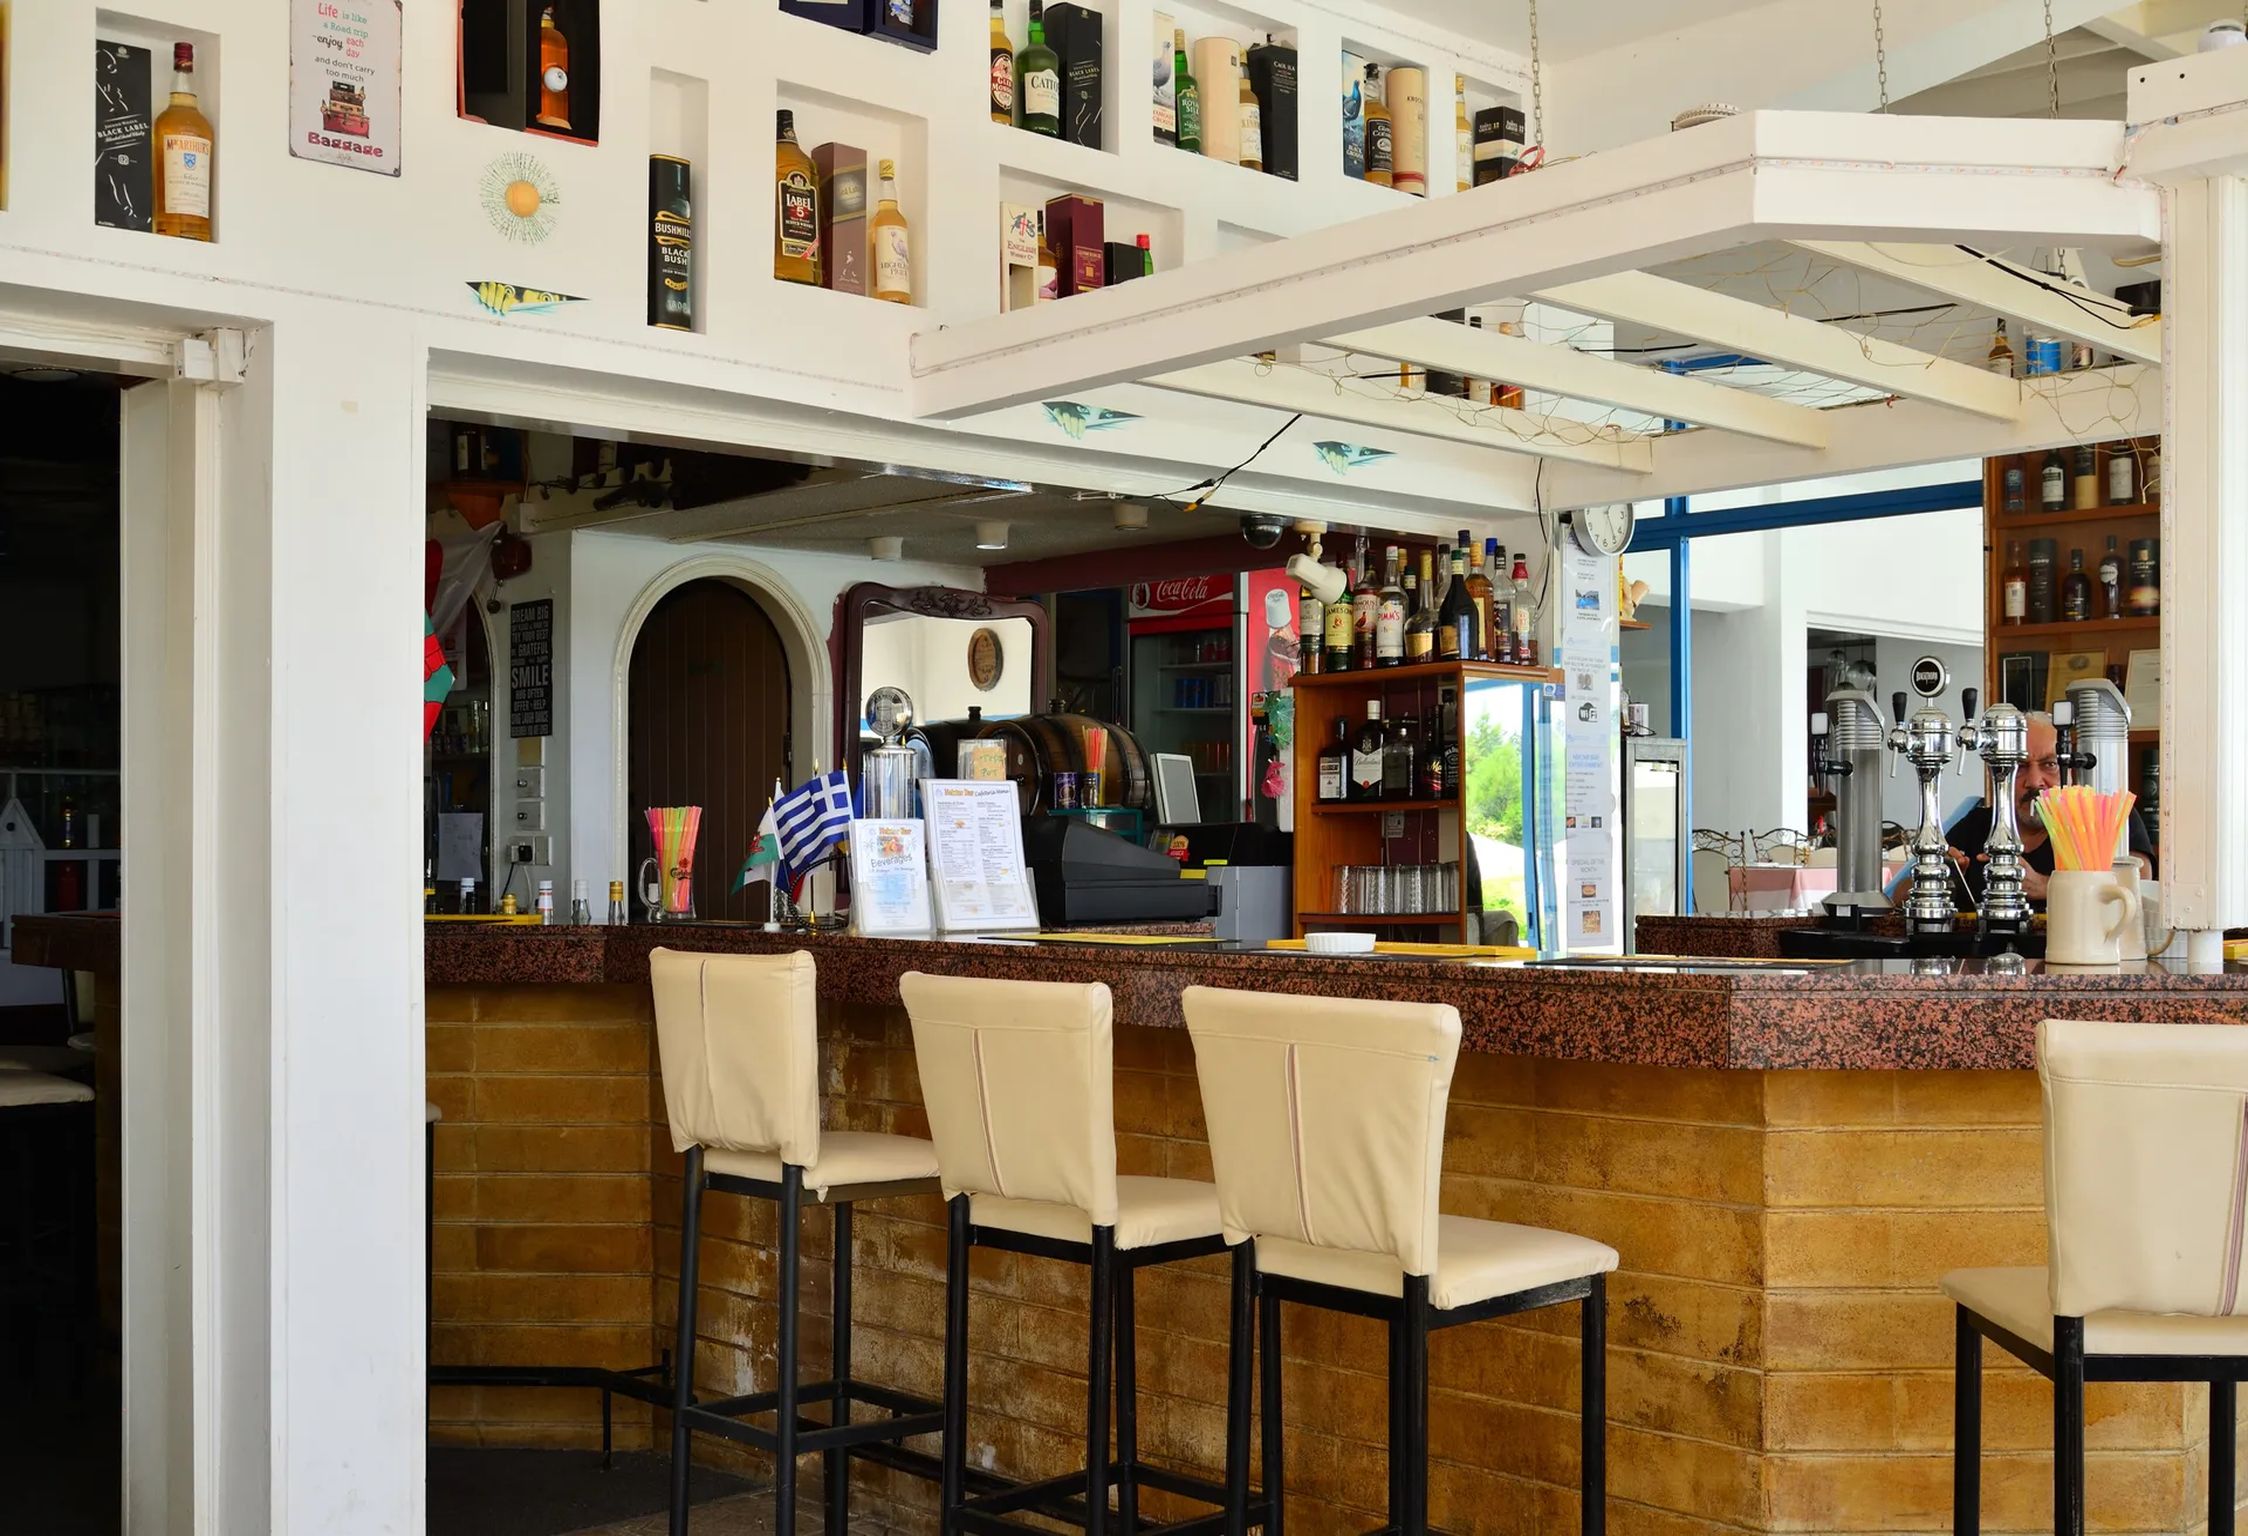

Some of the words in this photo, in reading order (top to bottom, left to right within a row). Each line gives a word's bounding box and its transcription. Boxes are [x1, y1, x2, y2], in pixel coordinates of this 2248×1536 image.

[318, 2, 338, 18] Life
[342, 11, 350, 19] is
[352, 13, 367, 24] like
[330, 22, 352, 34] Road
[353, 28, 368, 39] trip
[316, 35, 343, 51] enjoy
[346, 37, 365, 48] each
[346, 48, 360, 58] day
[314, 56, 331, 65] and
[332, 59, 353, 70] don't
[355, 65, 375, 76] carry
[326, 68, 340, 77] too
[341, 72, 364, 82] much
[97, 128, 123, 138] BLACK
[124, 122, 149, 132] LABEL
[308, 131, 383, 157] Baggage
[786, 193, 814, 211] LABEL
[796, 206, 805, 218] 5
[655, 222, 691, 238] BUSHMILL
[662, 246, 689, 258] BLACK
[664, 255, 688, 266] BUSH
[512, 607, 536, 623] DREAM
[537, 604, 549, 620] BIG
[1377, 609, 1401, 622] PIMM'S
[518, 641, 549, 656] GRATEFUL
[512, 664, 549, 689] SMILE
[871, 854, 912, 868] Beverages
